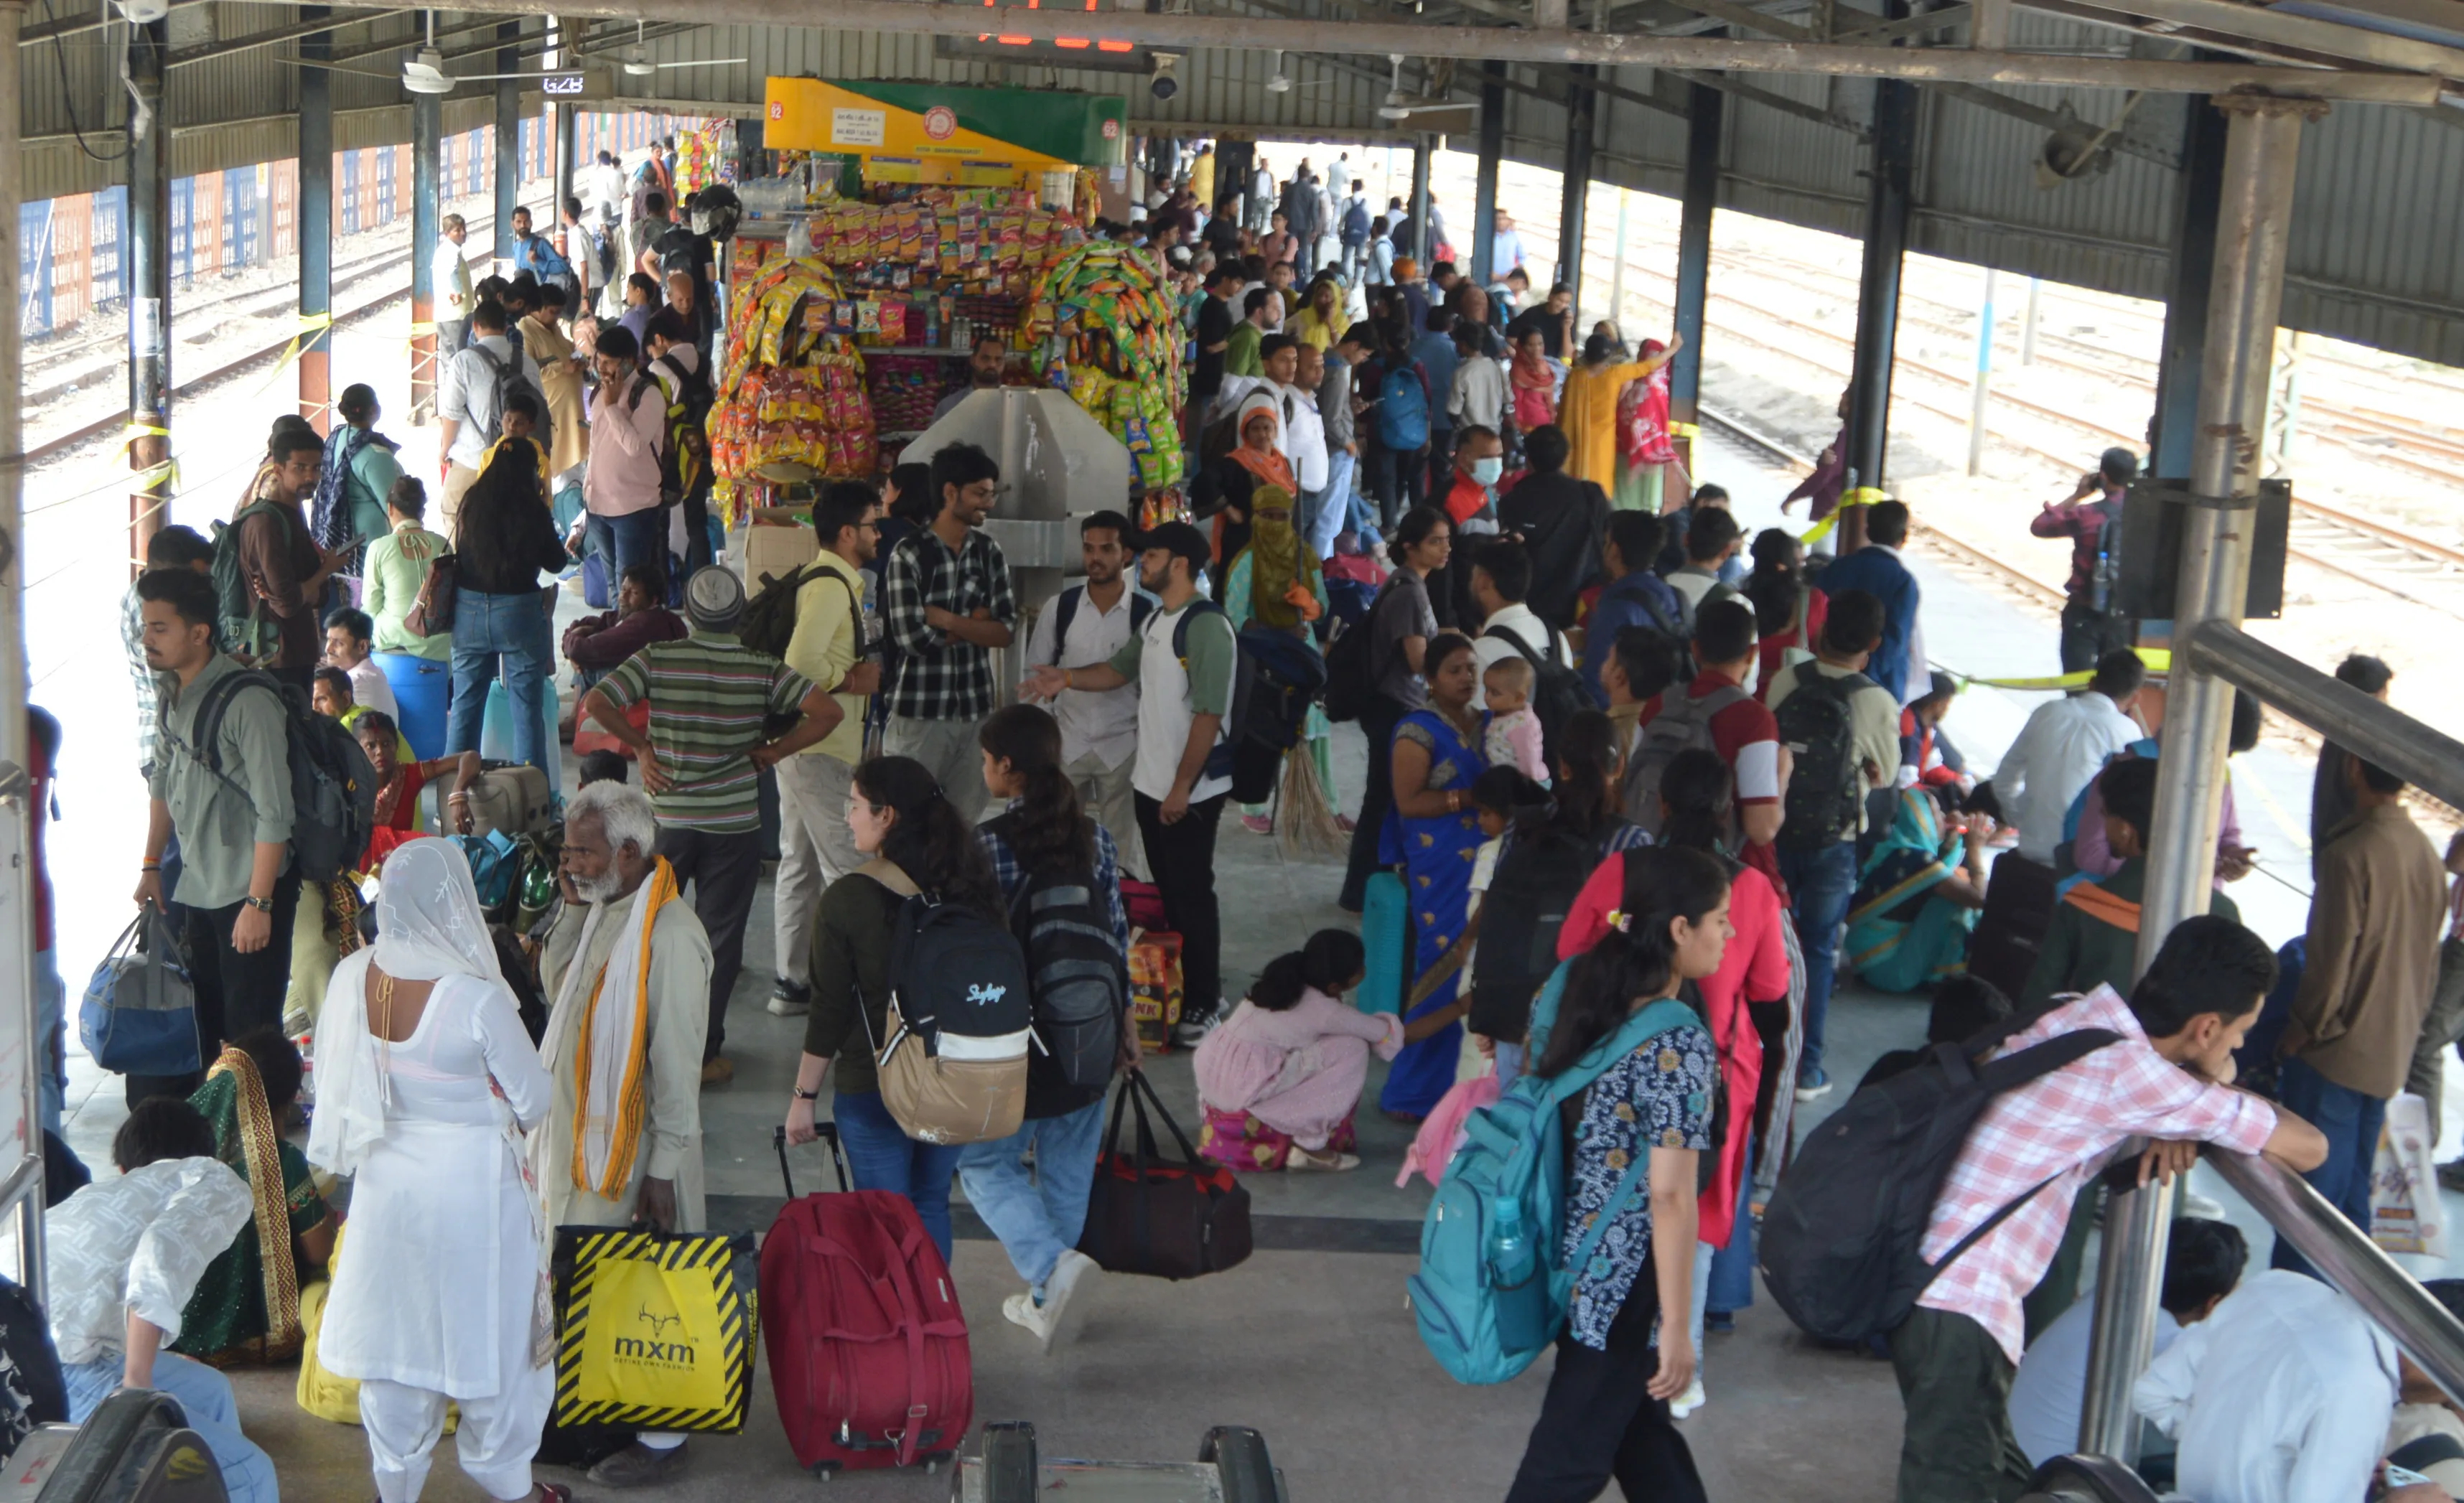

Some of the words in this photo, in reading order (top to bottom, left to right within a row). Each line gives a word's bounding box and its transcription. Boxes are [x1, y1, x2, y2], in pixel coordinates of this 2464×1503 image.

[770, 106, 782, 118] 92
[1104, 124, 1117, 137] 92
[1134, 1002, 1158, 1017] NK
[615, 1337, 695, 1364] mxm
